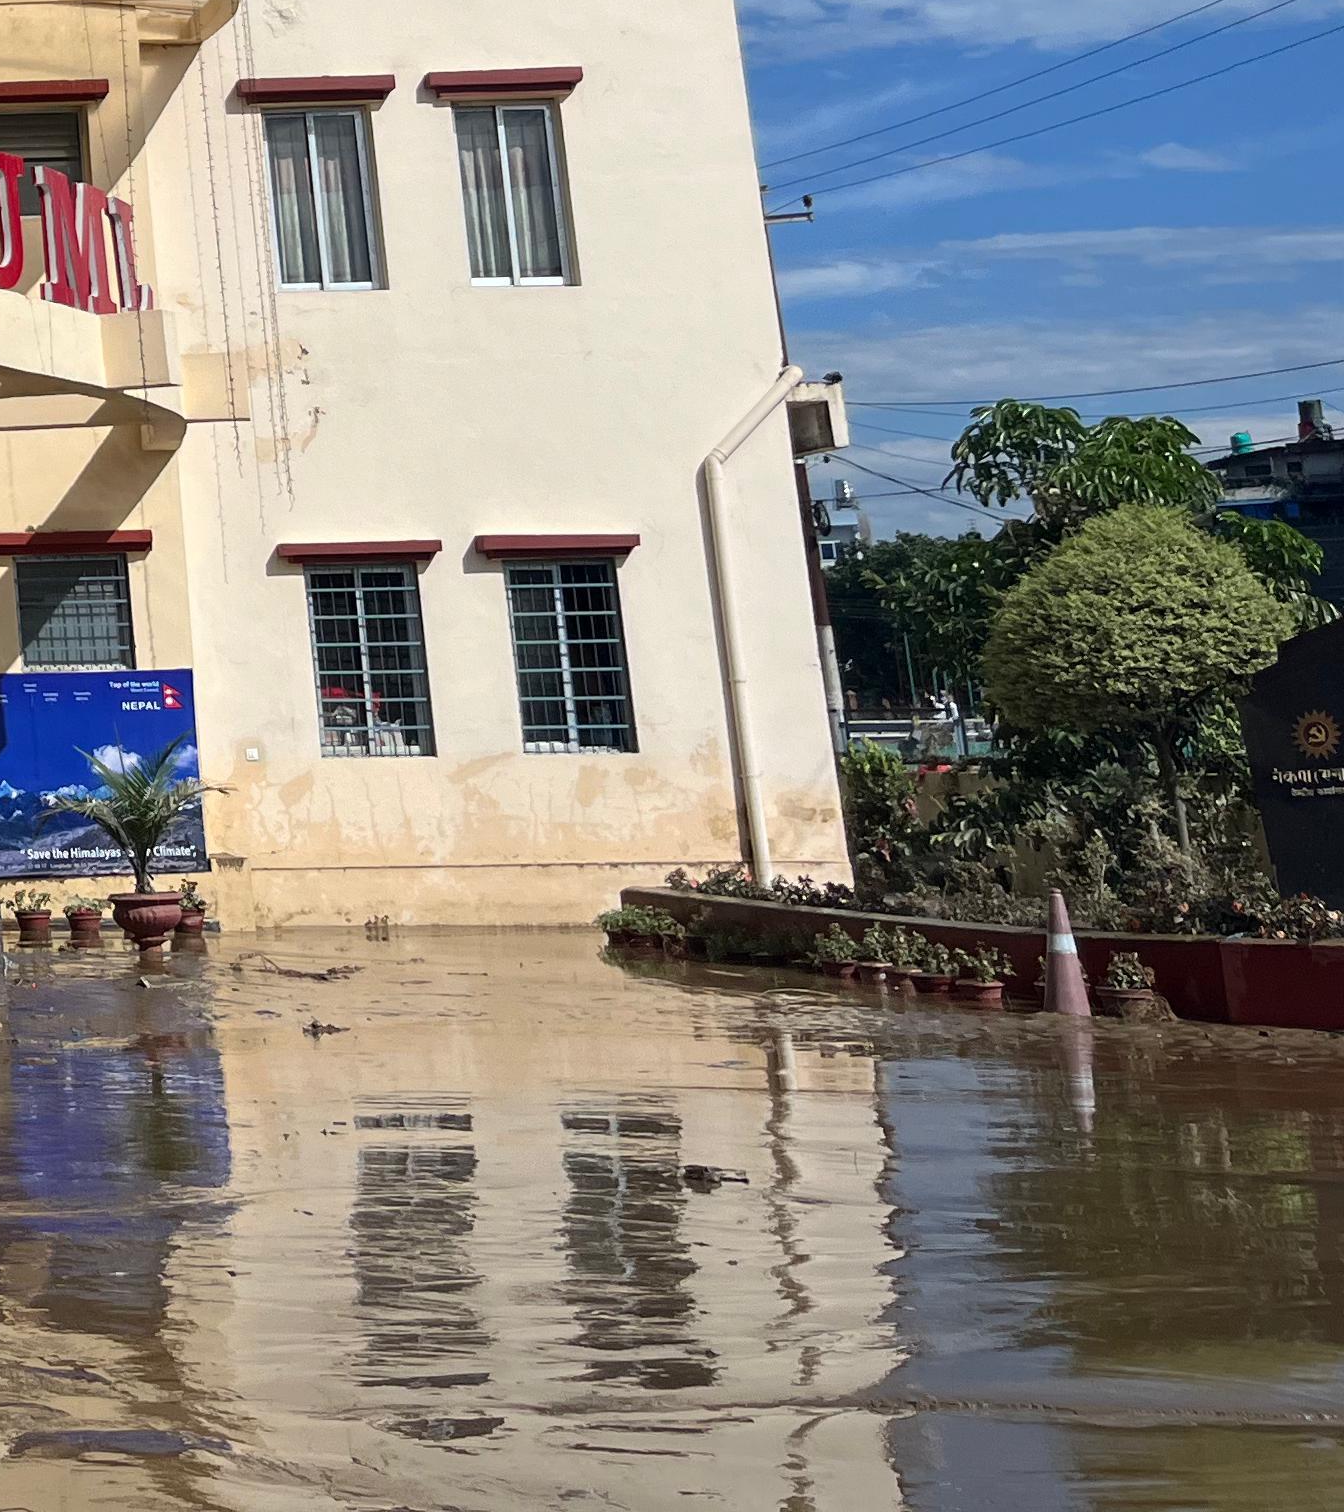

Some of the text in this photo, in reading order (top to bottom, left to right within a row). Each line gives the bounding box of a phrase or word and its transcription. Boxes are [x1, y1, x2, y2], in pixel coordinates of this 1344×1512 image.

[121, 701, 161, 710] NEPAL
[52, 847, 69, 859] the
[70, 846, 122, 861] Himalayas
